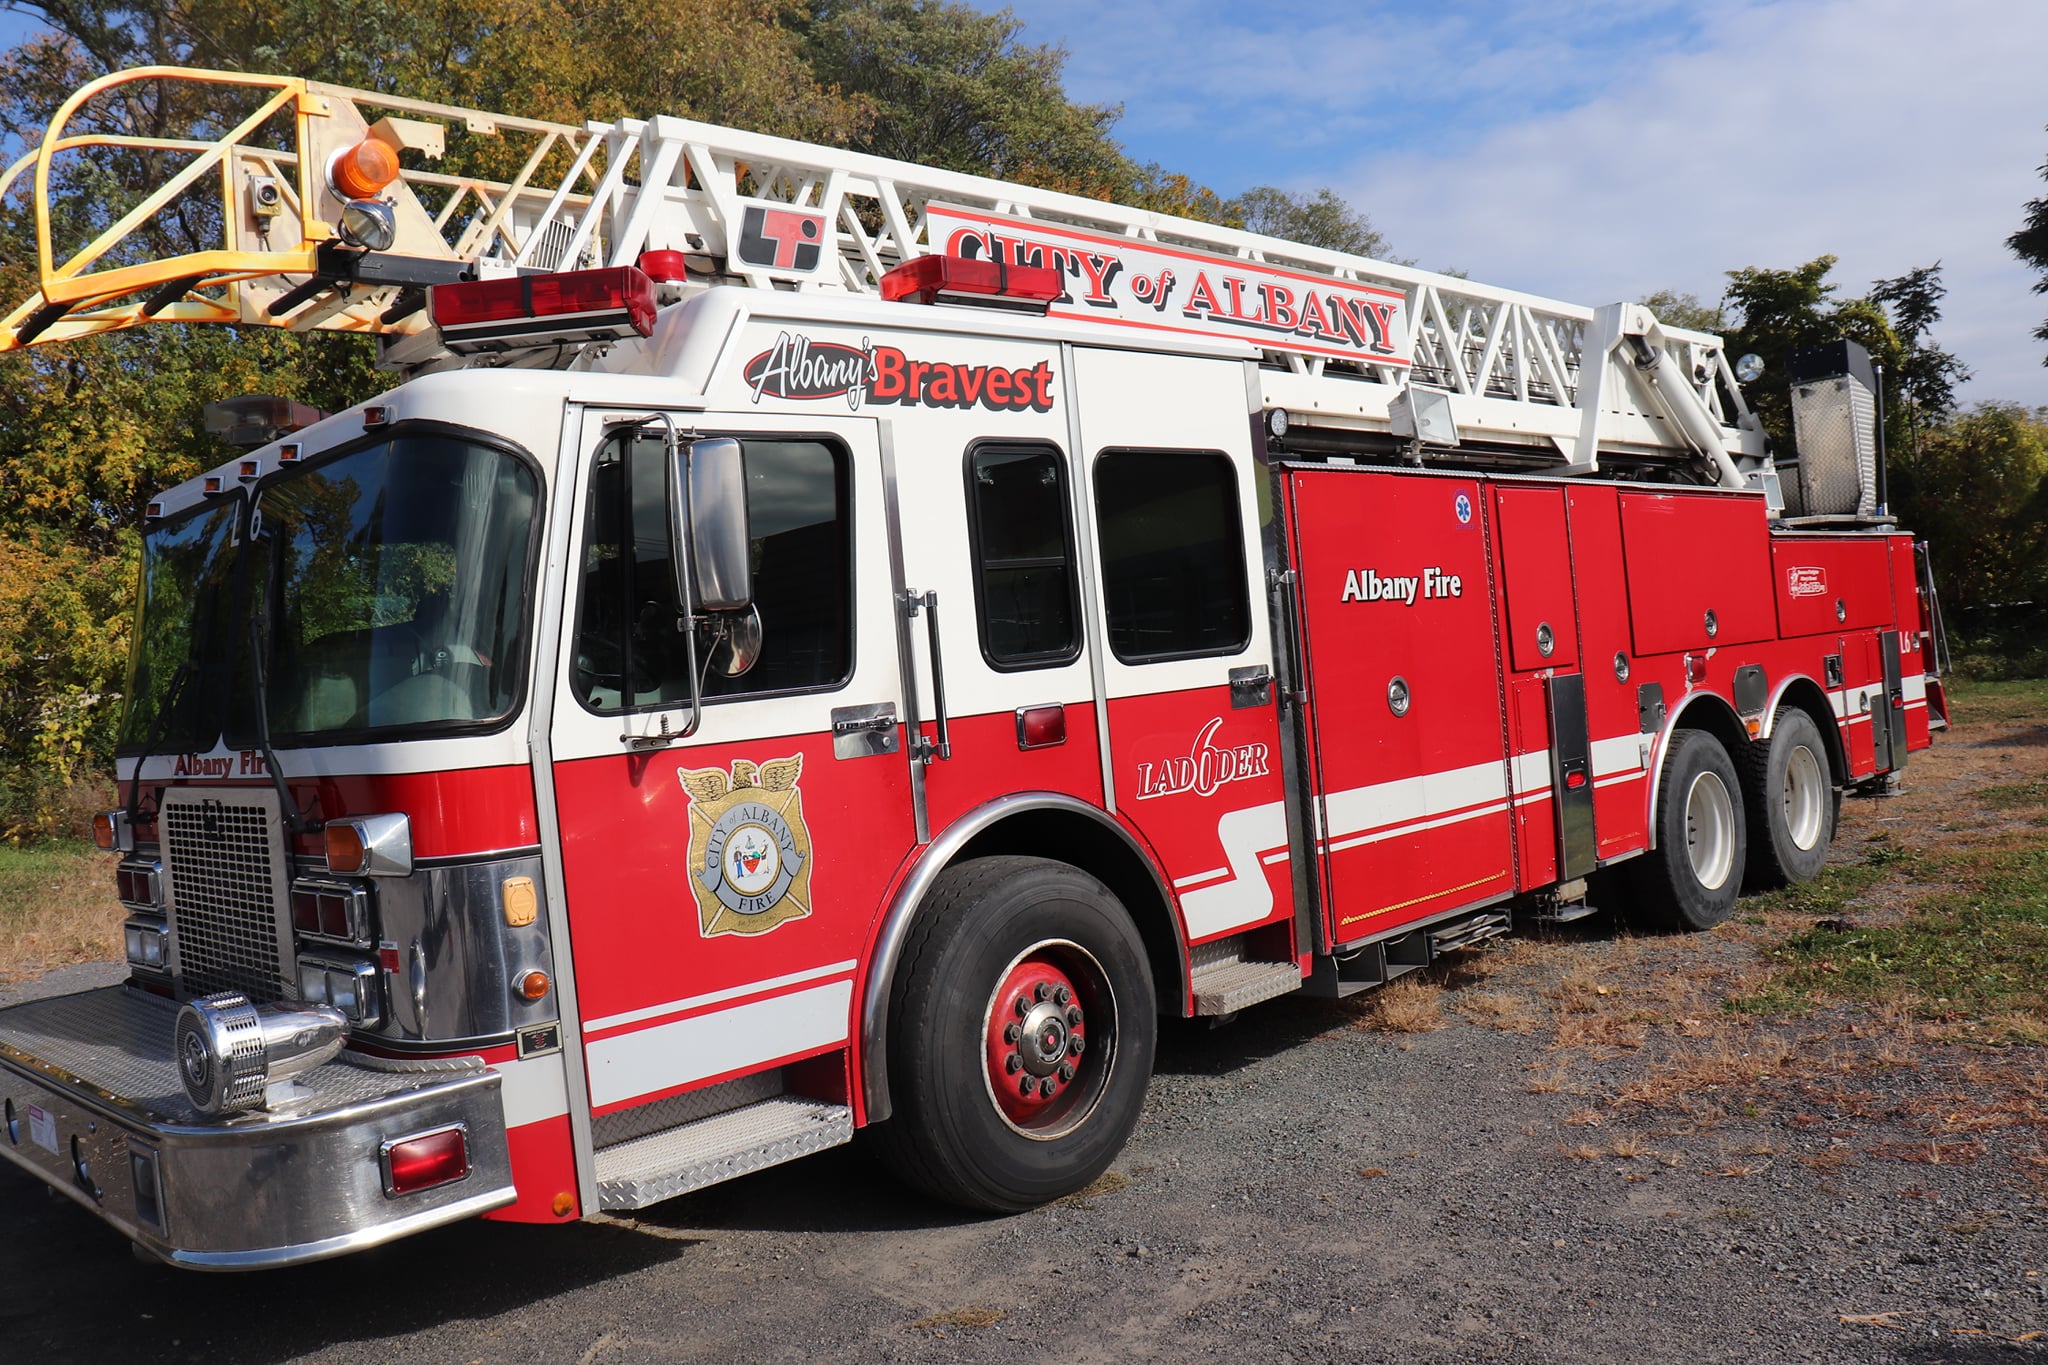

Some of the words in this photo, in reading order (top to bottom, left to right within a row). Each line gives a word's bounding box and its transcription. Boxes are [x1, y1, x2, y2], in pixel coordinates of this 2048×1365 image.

[1131, 269, 1176, 312] of
[1183, 272, 1397, 354] ALBANY
[750, 330, 879, 411] Albany's
[867, 346, 1054, 412] Bravest
[1341, 568, 1419, 606] Albany
[1423, 565, 1462, 599] Fire
[1899, 631, 1911, 654] L6
[174, 753, 234, 779] Albany
[708, 824, 727, 868] CITY
[728, 811, 738, 825] of
[742, 807, 792, 851] ALBANY
[739, 892, 776, 911] FIRE
